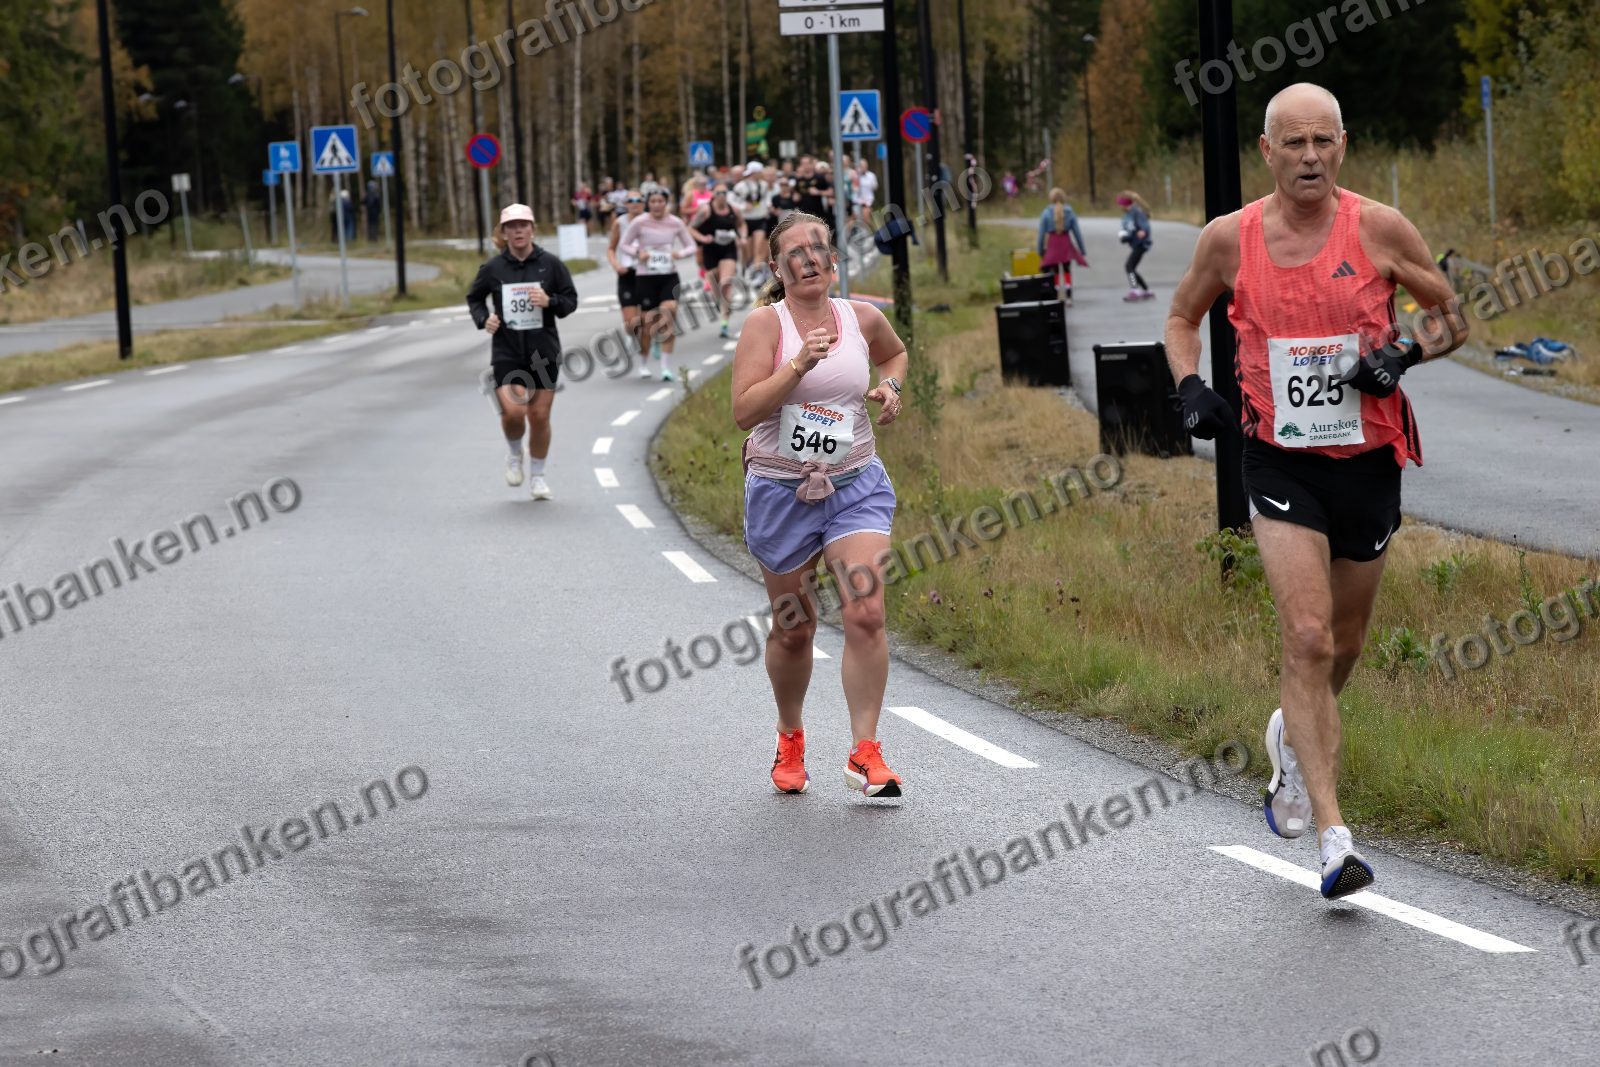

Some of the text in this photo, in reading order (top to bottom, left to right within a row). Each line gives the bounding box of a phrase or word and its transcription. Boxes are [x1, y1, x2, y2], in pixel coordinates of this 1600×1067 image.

[804, 16, 814, 29] 0
[840, 15, 860, 27] km
[511, 299, 534, 313] 393
[1289, 343, 1344, 356] NORGES
[1293, 355, 1335, 366] LØPET
[1287, 374, 1344, 408] 625
[802, 401, 844, 421] NORGES
[802, 411, 836, 427] LØPET
[1309, 420, 1359, 433] Aurskog
[791, 425, 837, 455] 546
